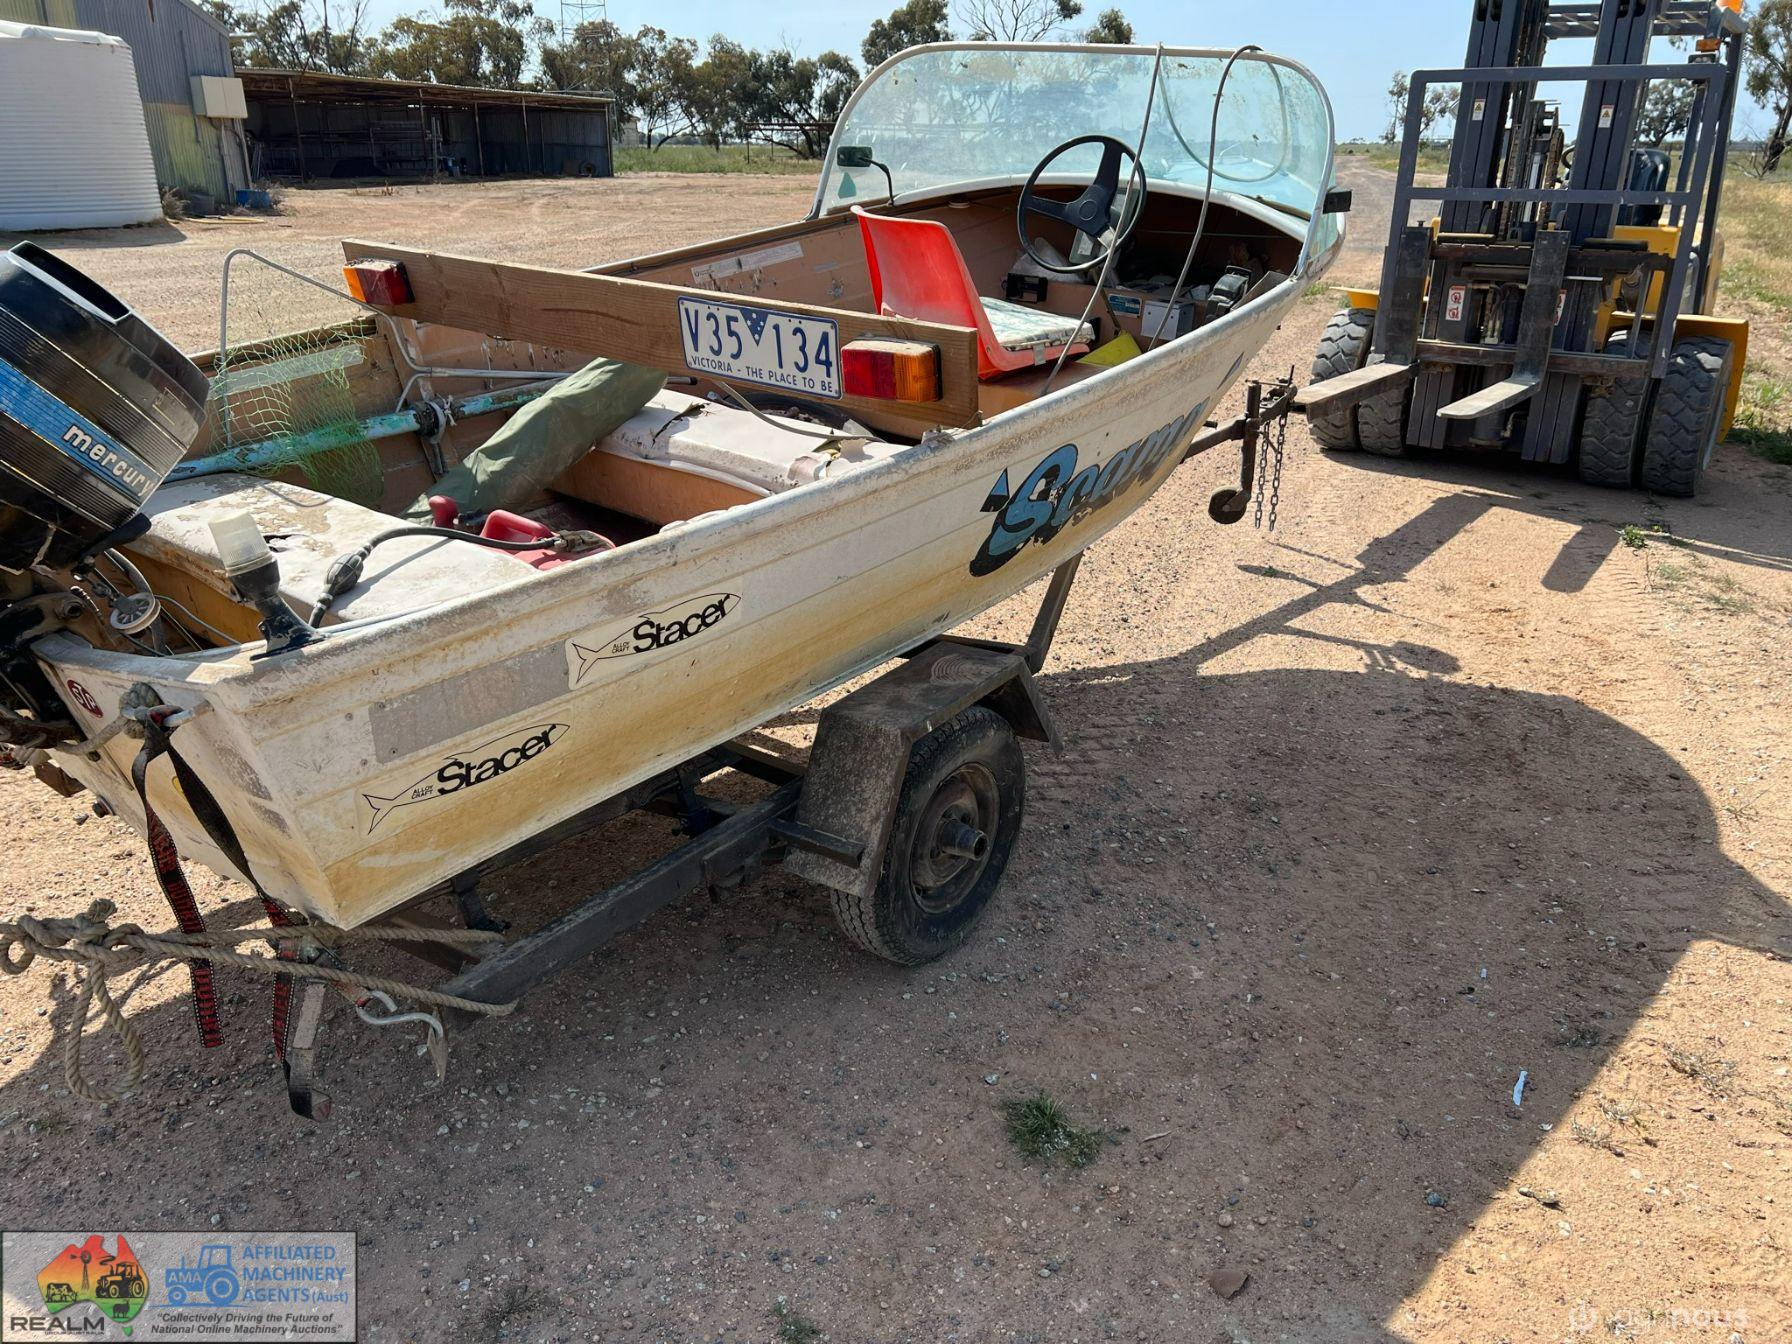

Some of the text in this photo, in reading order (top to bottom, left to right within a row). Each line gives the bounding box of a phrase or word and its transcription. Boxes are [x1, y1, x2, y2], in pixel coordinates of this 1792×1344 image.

[685, 307, 833, 379] V35 134
[691, 355, 733, 373] VICTORIA
[746, 366, 763, 379] THE
[768, 370, 798, 386] PLACE
[802, 376, 815, 389] TO
[821, 380, 833, 393] BE
[62, 424, 156, 497] mercury
[633, 593, 731, 653] Stacer
[437, 724, 557, 795] Stacer
